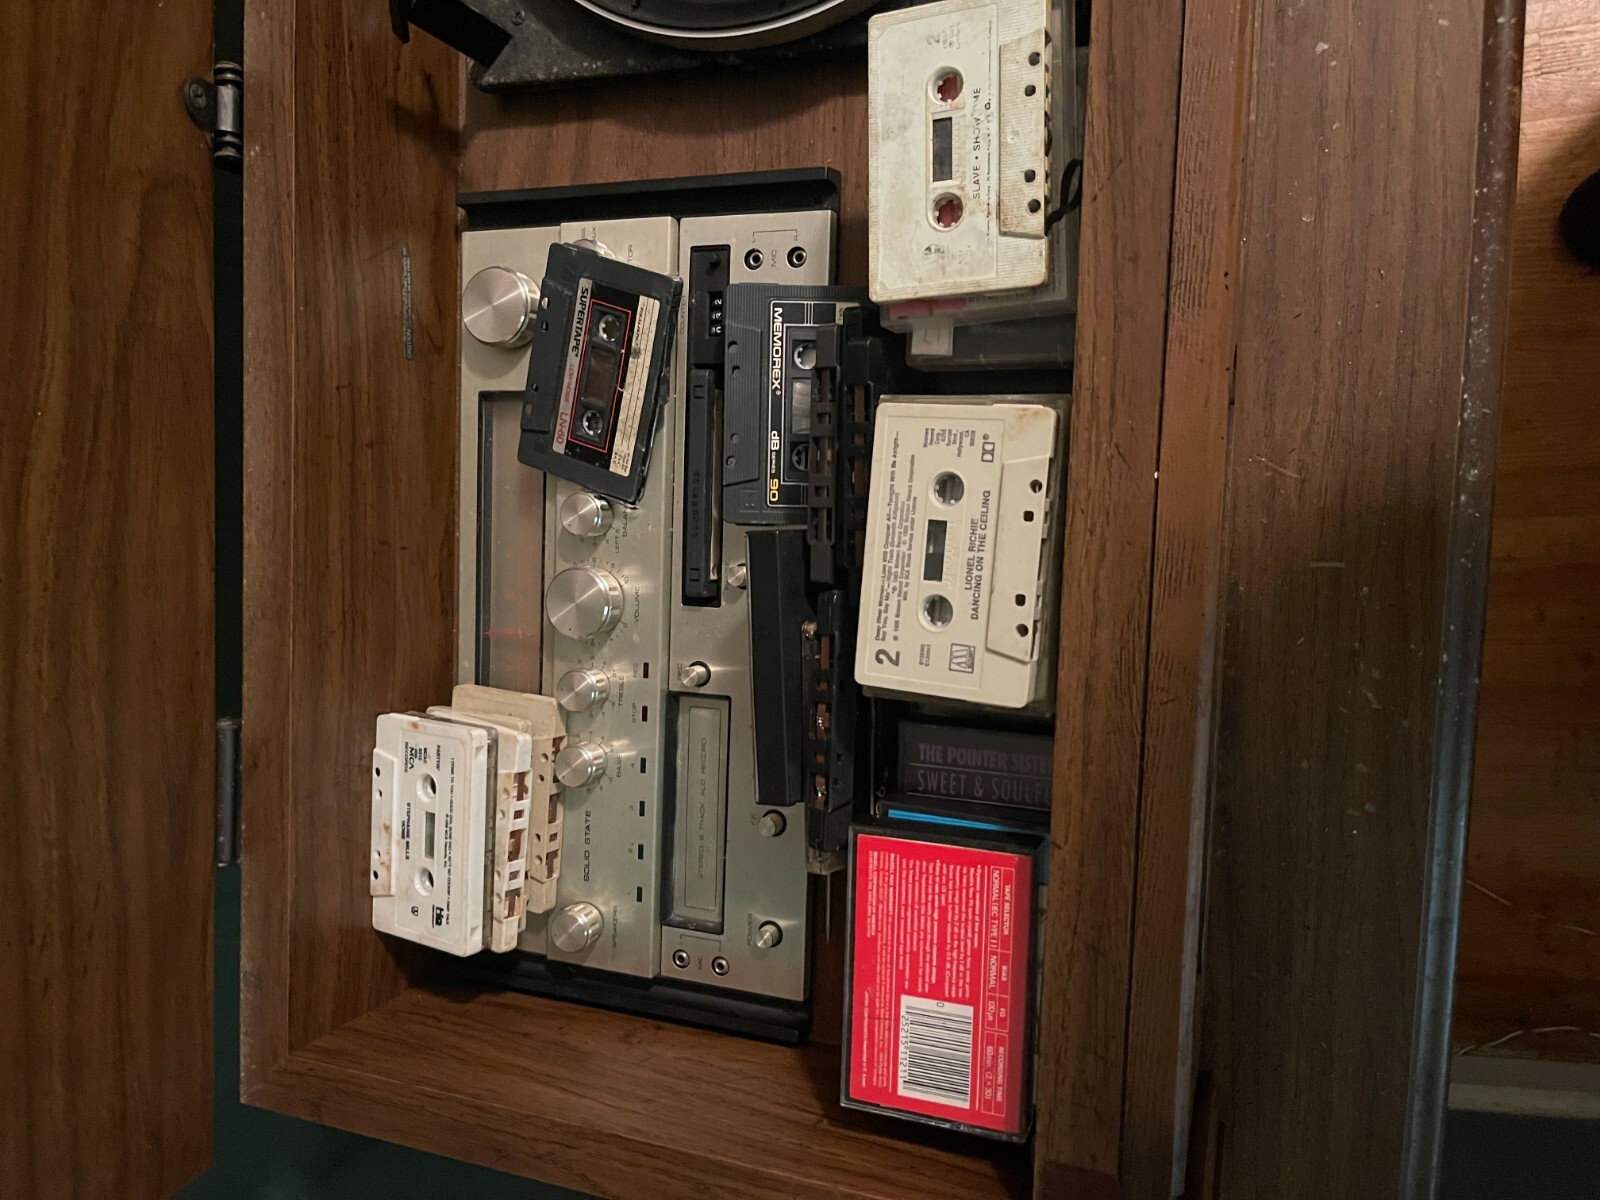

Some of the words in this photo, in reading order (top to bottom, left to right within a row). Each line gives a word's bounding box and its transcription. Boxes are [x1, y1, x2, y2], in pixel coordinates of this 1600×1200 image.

[973, 87, 981, 151] SHOWME
[572, 286, 590, 353] SUPERTAPE
[772, 307, 783, 390] MEMOREX
[771, 430, 780, 451] dB
[770, 478, 779, 502] 90
[979, 490, 990, 531] CEILING
[968, 518, 978, 552] RICHIE
[977, 533, 986, 551] THE
[965, 555, 975, 590] LIONEL
[975, 556, 984, 572] ON
[970, 574, 982, 620] DANCING
[875, 649, 900, 667] 2
[918, 743, 944, 763] THE
[948, 745, 1008, 769] POINTER
[917, 769, 967, 797] SWEET
[973, 775, 984, 799] &
[584, 809, 592, 845] STATE
[992, 869, 1000, 902] NORMAL
[990, 920, 999, 938] TYPE
[1002, 902, 1010, 936] SELECTOR
[988, 955, 998, 990] NORMAL
[901, 1014, 910, 1046] 25215
[900, 1050, 908, 1080] 11211
